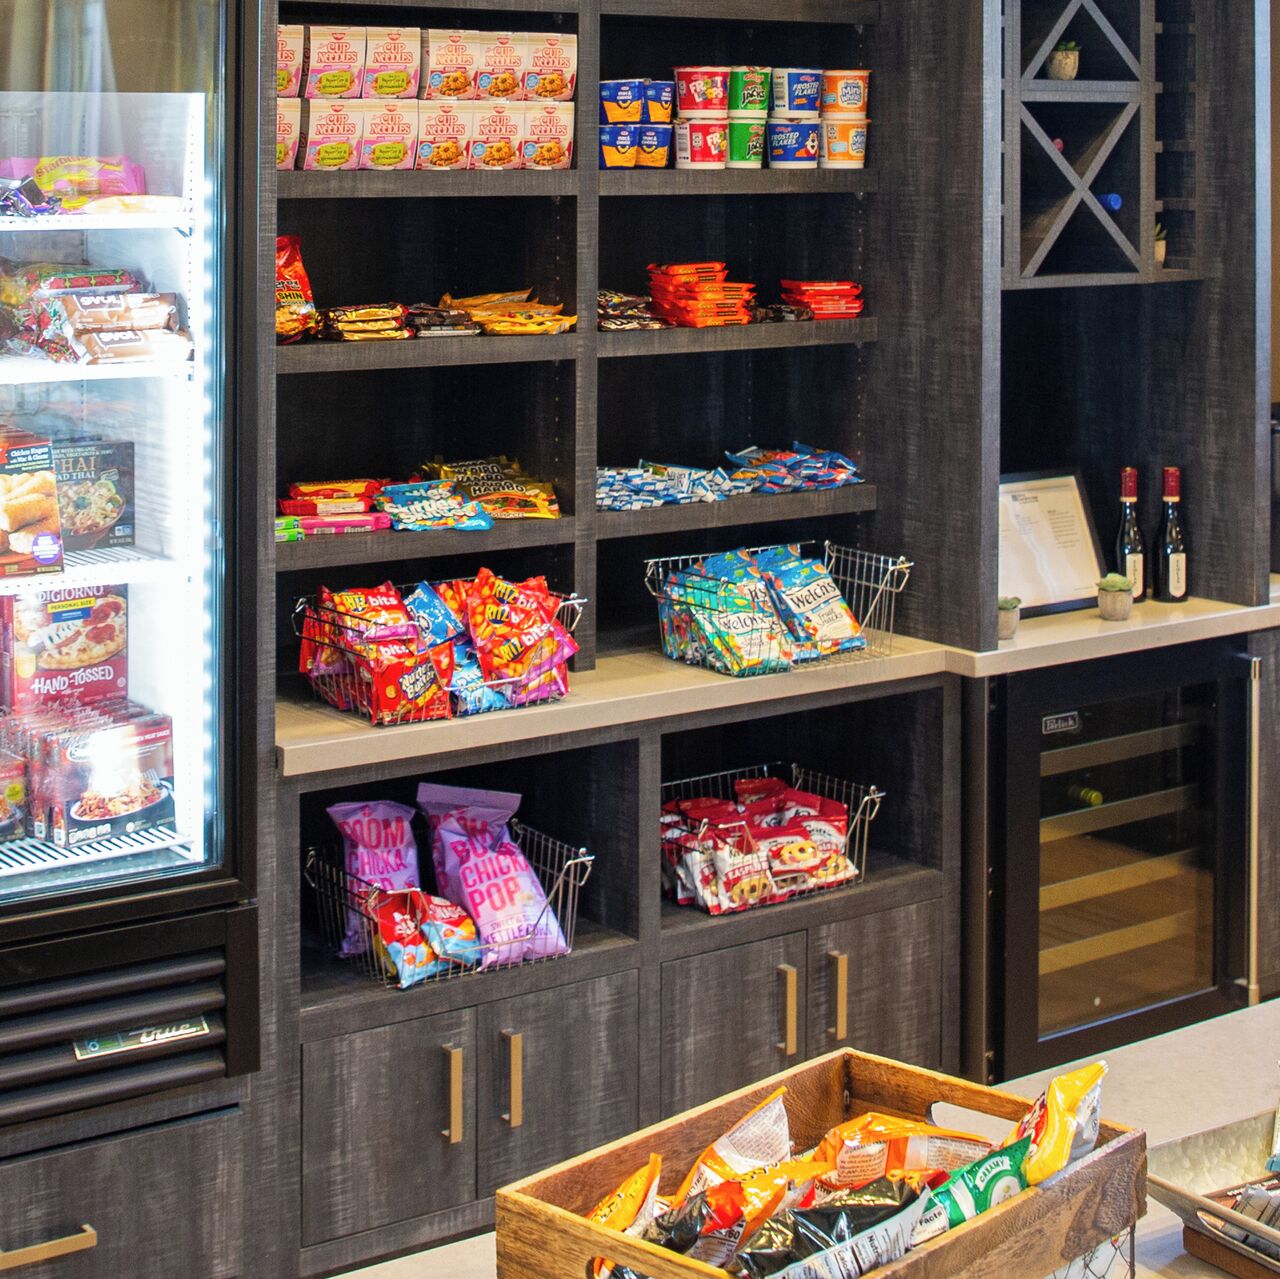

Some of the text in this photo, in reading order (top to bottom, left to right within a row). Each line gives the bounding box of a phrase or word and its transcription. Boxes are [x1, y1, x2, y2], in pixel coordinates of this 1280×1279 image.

[326, 42, 350, 53] CUP
[384, 42, 406, 54] CUP
[443, 44, 466, 56] CUP
[492, 46, 515, 58] CUP
[542, 47, 563, 58] CUP
[316, 52, 358, 64] NOODLES
[373, 52, 414, 64] NOODLES
[434, 54, 474, 66] NOODLES
[484, 56, 522, 67] NOODLES
[532, 56, 570, 68] NOODLES
[792, 82, 819, 93] FROSTED
[795, 87, 818, 97] FLAKES
[742, 90, 765, 104] JACKS
[325, 114, 349, 125] CUP
[380, 114, 402, 125] CUP
[434, 114, 458, 126] CUP
[487, 115, 510, 126] CUP
[538, 115, 559, 126] CUP
[315, 123, 356, 136] NOODLES
[369, 123, 411, 136] NOODLES
[424, 124, 466, 137] NOODLES
[478, 124, 518, 137] NOODLES
[528, 124, 568, 137] NOODLES
[277, 292, 304, 300] SHIN
[72, 470, 96, 481] THAI
[471, 481, 526, 497] HARIBO
[492, 578, 519, 604] RITZ
[789, 580, 838, 610] Welch's
[343, 593, 399, 611] RITZ bits
[485, 604, 512, 623] RITZ
[379, 643, 409, 656] bits
[499, 624, 550, 663] RITZ bits
[467, 877, 521, 921] POP
[978, 1157, 1006, 1183] CREAMY
[919, 1210, 943, 1225] Facts
